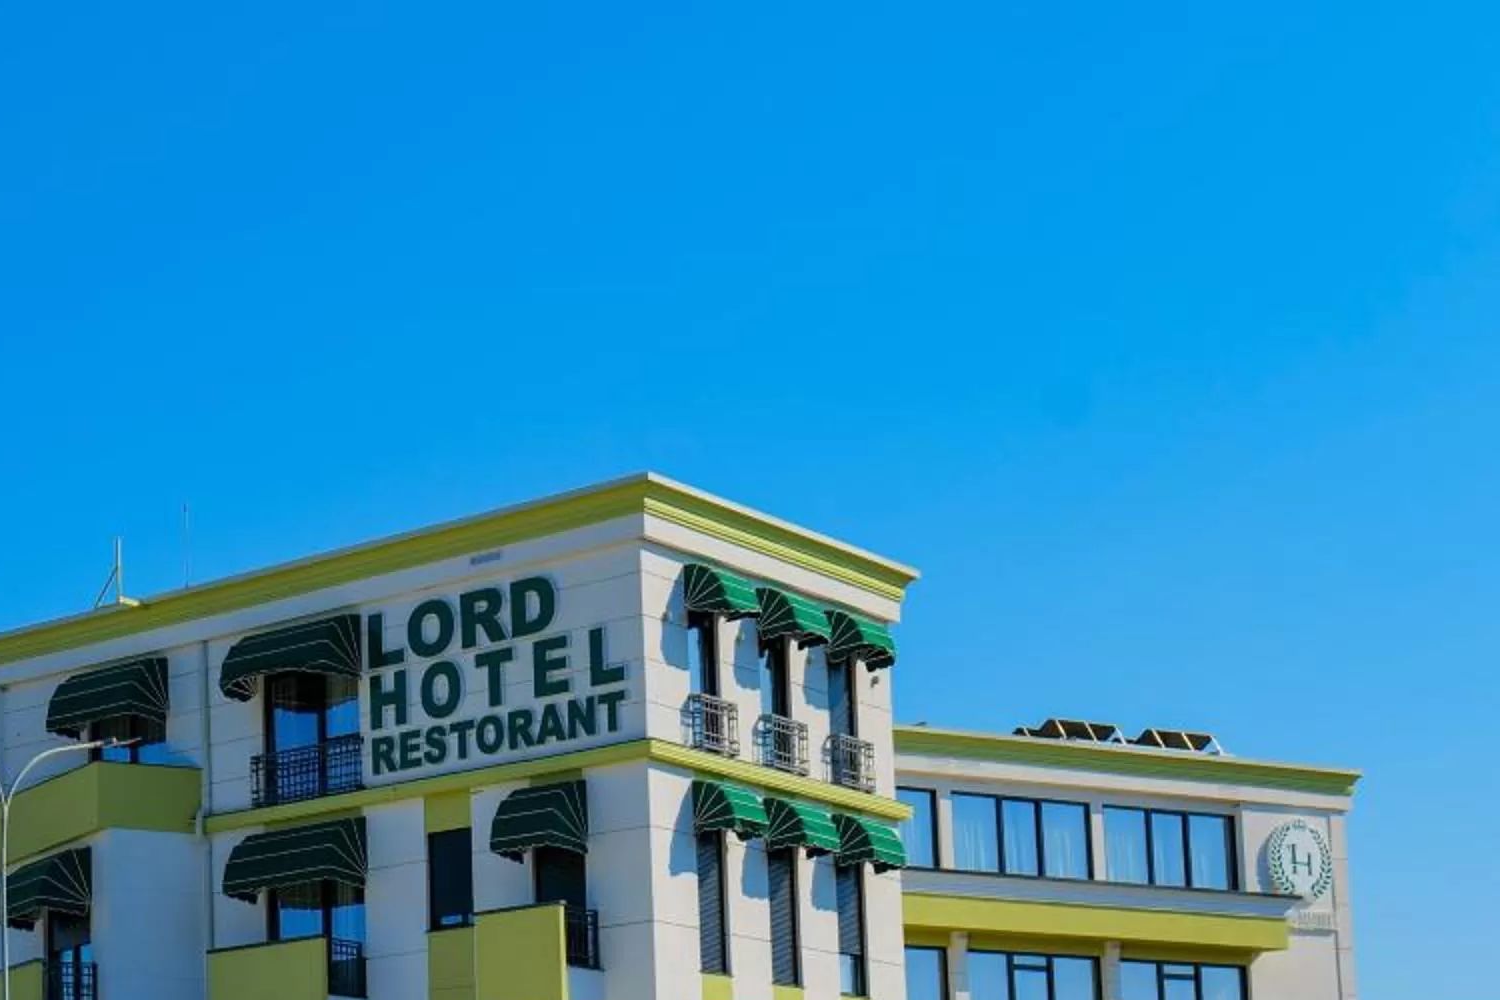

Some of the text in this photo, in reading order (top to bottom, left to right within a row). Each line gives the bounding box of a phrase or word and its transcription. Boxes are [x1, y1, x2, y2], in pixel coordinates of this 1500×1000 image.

[367, 575, 556, 670] LORD
[368, 626, 626, 731] HOTEL
[371, 689, 626, 776] RESTORANT
